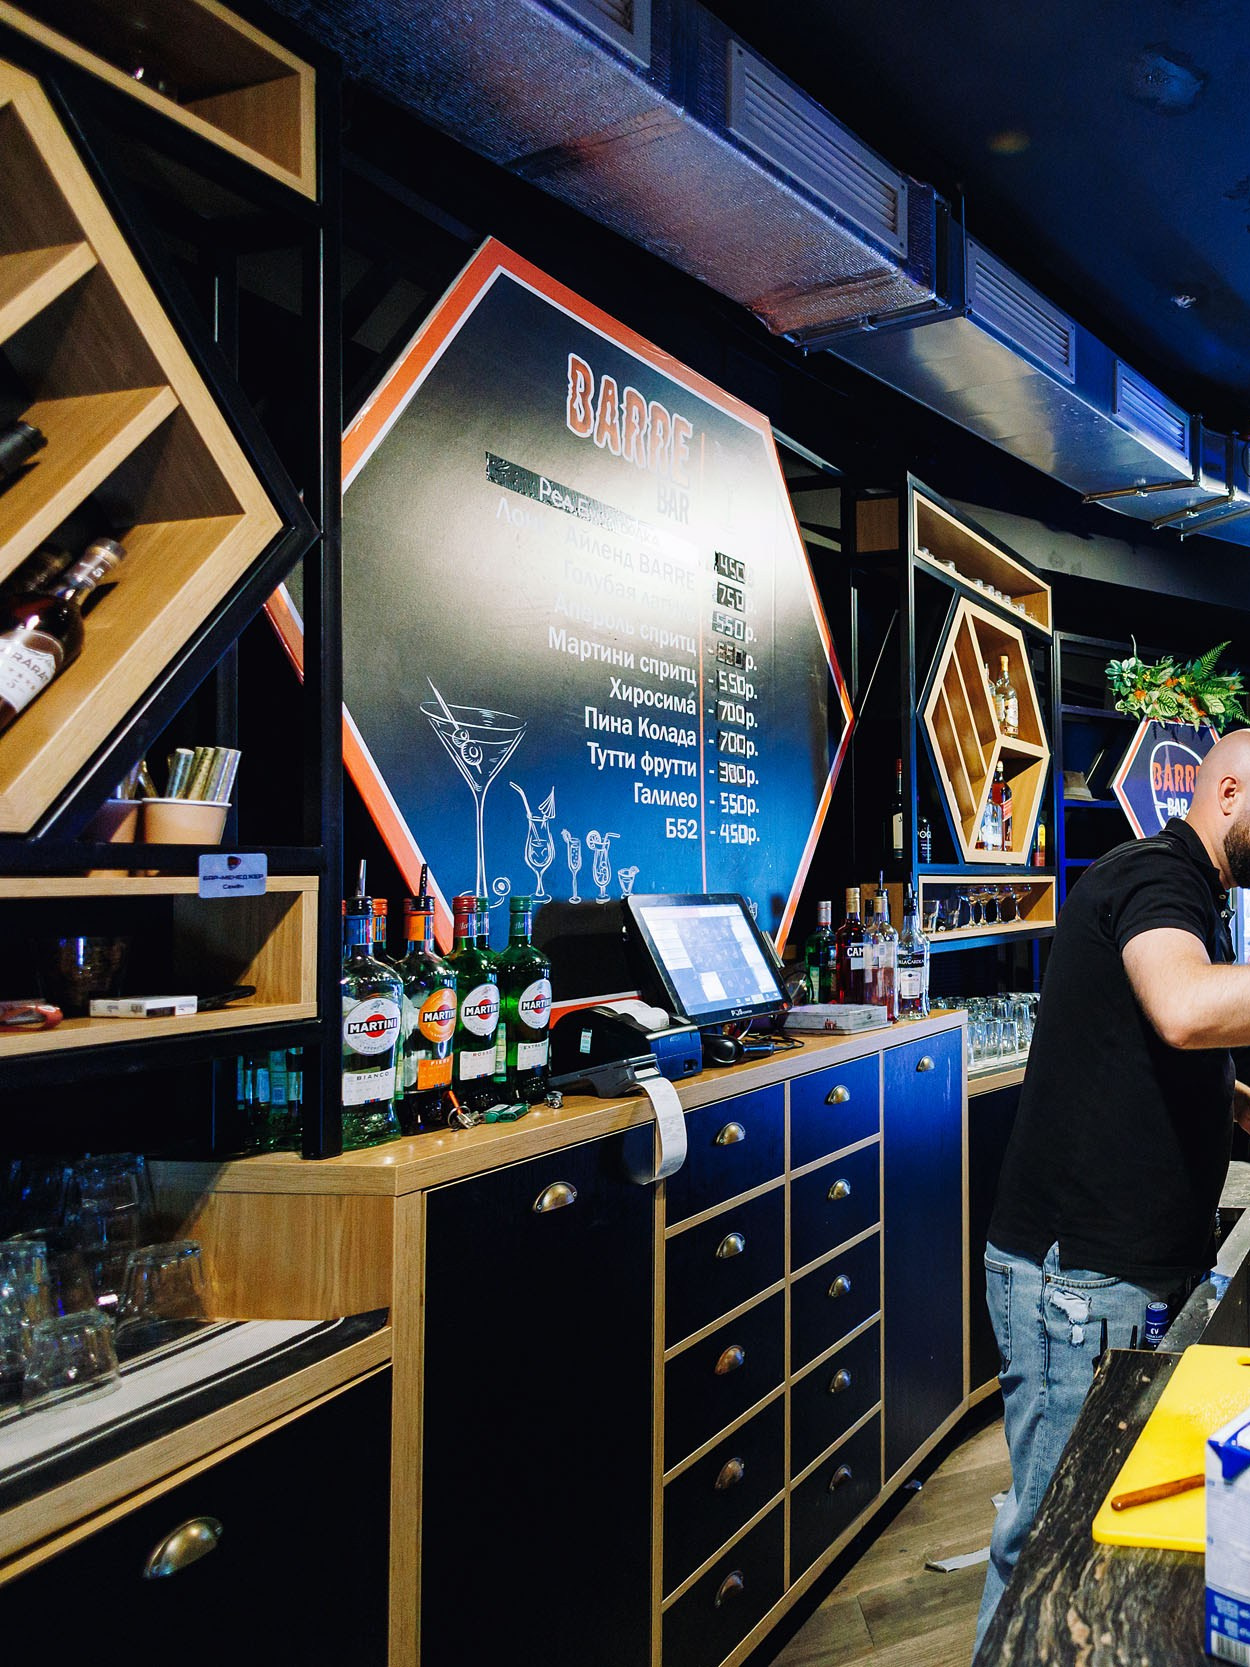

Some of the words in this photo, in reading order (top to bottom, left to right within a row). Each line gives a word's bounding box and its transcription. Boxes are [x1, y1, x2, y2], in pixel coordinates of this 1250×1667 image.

[567, 353, 693, 490] BARRE
[656, 484, 690, 525] BAR
[564, 524, 635, 572] Айленд
[640, 552, 696, 592] BARRE
[563, 558, 637, 601] Голубая
[554, 591, 636, 638] Апероль
[640, 625, 697, 656] спритц
[548, 626, 635, 669] Мартини
[640, 656, 697, 687] спритц
[609, 677, 697, 715] Хиросима
[584, 706, 633, 736] Пина
[638, 717, 697, 747] Колада
[586, 741, 636, 771] Тутти
[640, 751, 697, 778] фрутти
[1152, 762, 1200, 793] BARR
[633, 782, 698, 808] Галилео
[1167, 798, 1188, 816] BAR
[665, 818, 698, 840] Б52
[349, 1018, 397, 1034] MARTINI
[424, 1009, 456, 1023] MARTIN
[465, 1002, 498, 1016] MARTIN
[356, 1071, 390, 1081] BIANCO
